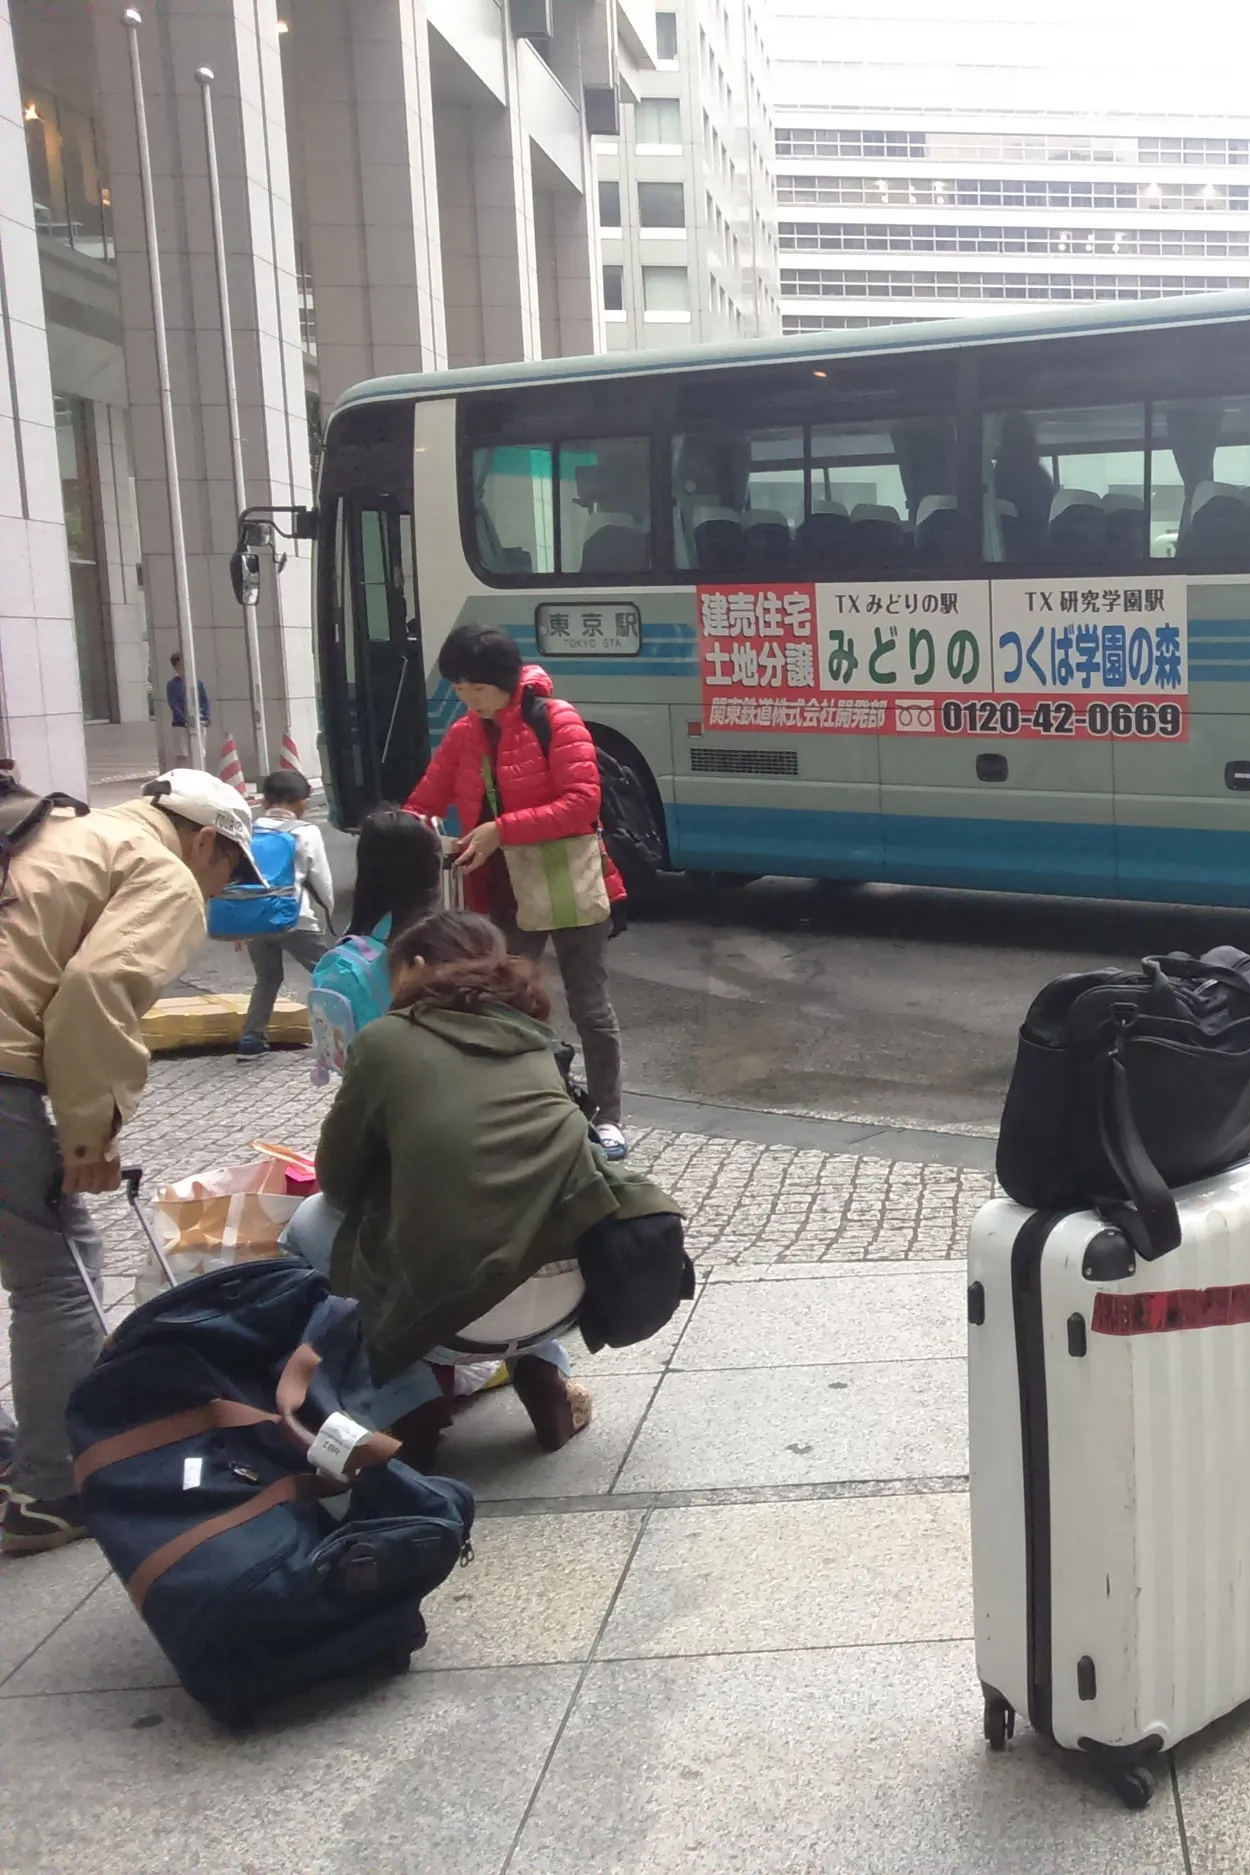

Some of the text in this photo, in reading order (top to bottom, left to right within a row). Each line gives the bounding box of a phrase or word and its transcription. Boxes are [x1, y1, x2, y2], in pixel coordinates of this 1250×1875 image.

[701, 590, 812, 639] 建売住宅
[835, 592, 959, 615] TX みどりの駅
[1025, 588, 1166, 613] TX 研究学園駅
[548, 611, 639, 638] 東京駅
[564, 637, 622, 649] TOKYO STA
[828, 624, 981, 686] みどりの
[998, 622, 1183, 690] つくば学園の森
[704, 641, 816, 688] 土地分譲
[709, 696, 888, 729] 関東鉄道株式会社開発部
[941, 700, 1182, 737] 0120-42-0669
